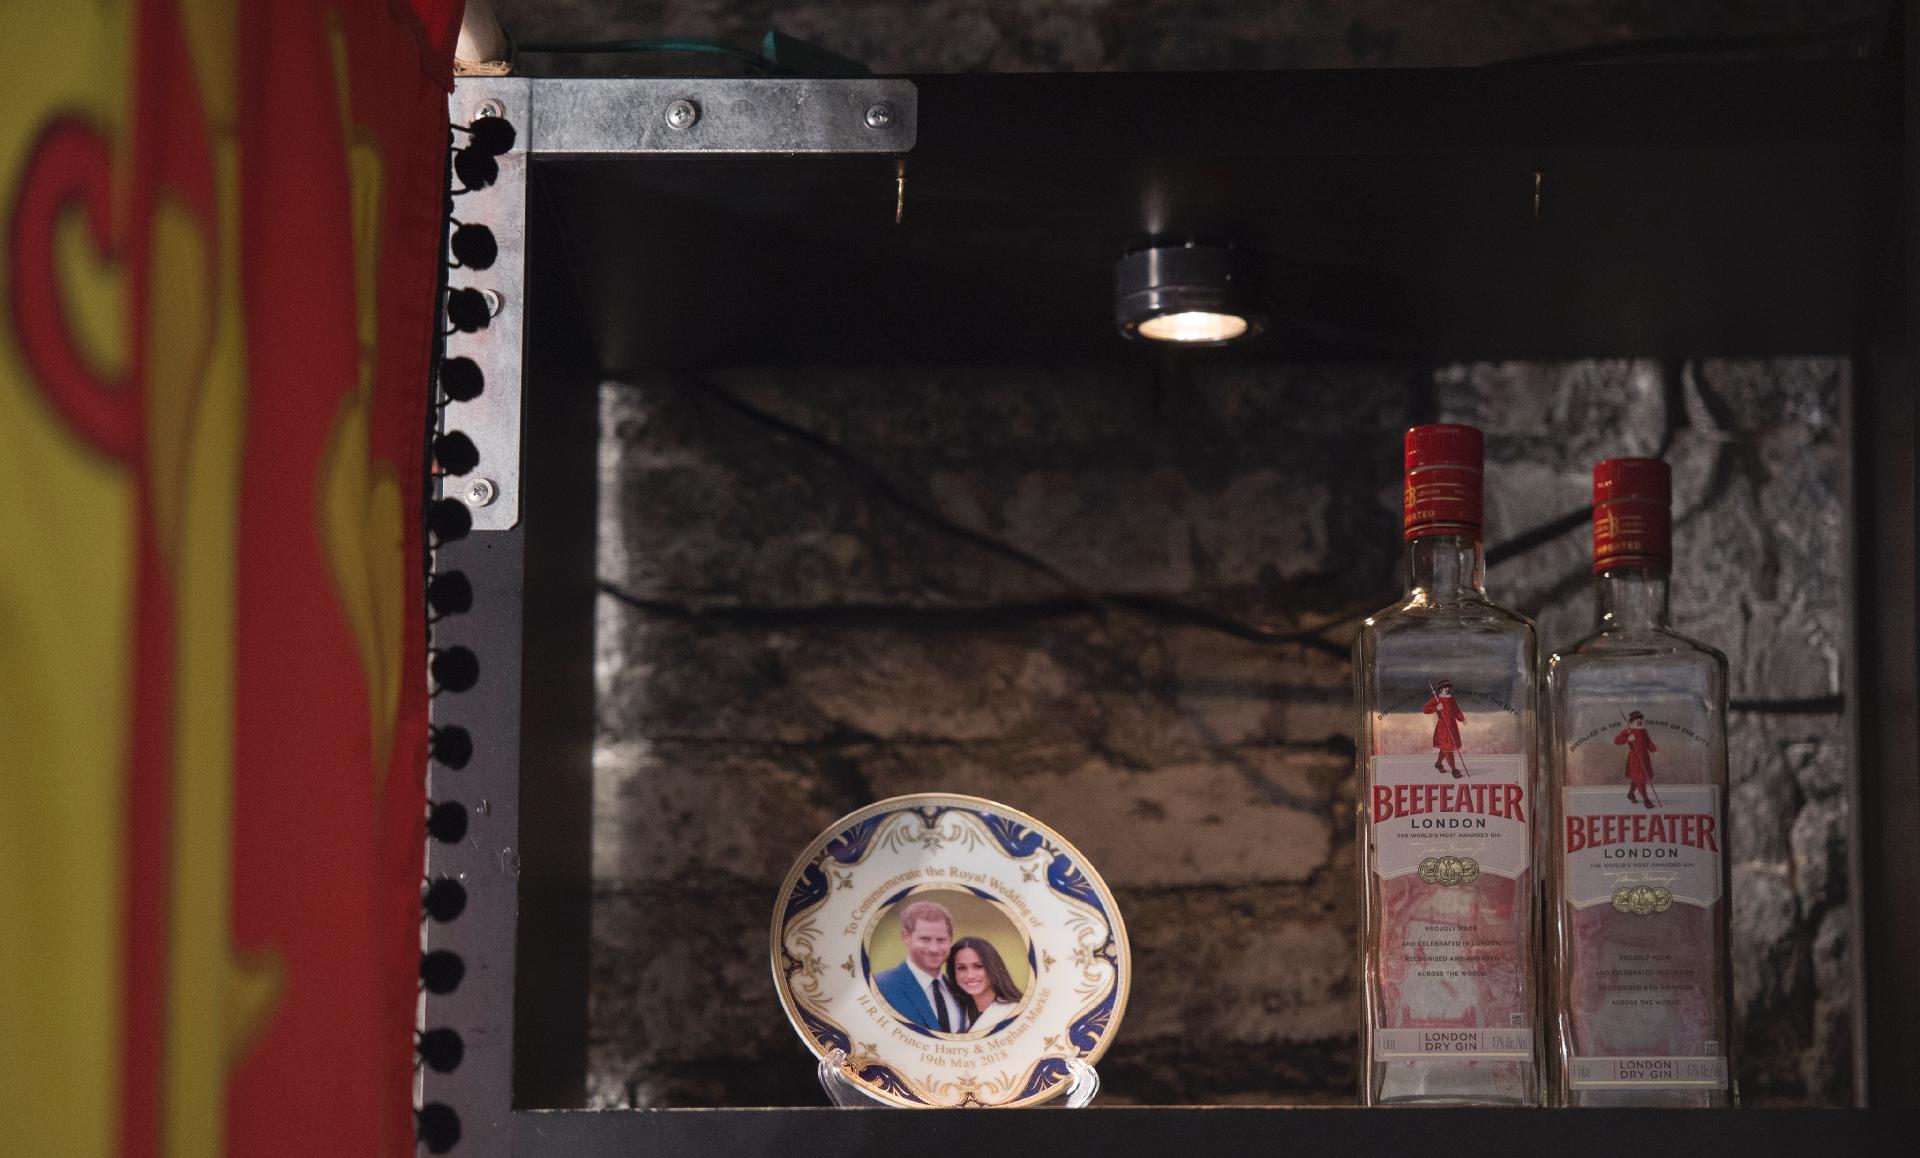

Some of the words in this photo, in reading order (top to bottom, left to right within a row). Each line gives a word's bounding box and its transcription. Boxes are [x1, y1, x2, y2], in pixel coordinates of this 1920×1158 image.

[1373, 783, 1526, 824] BEEFEATER
[1411, 818, 1486, 829] LONDON
[1566, 813, 1718, 854] BEEFEATER
[1604, 848, 1678, 859] LONDON
[843, 920, 859, 936] To
[852, 868, 922, 920] Commemorate
[926, 866, 945, 877] the
[950, 866, 986, 884] Royal
[989, 876, 1036, 919] Wedding
[1029, 914, 1044, 928] of
[892, 1027, 930, 1052] Prince
[935, 1043, 970, 1055] Harry
[974, 1043, 984, 1054] &
[987, 1023, 1030, 1052] Meghan
[1026, 986, 1050, 1023] Markle
[1425, 1032, 1477, 1041] LONDON
[1425, 1042, 1449, 1051] DRY
[1455, 1042, 1477, 1051] GIN
[919, 1053, 946, 1067] 19th
[950, 1055, 977, 1069] May
[981, 1050, 1009, 1066] 2018
[1620, 1060, 1672, 1069] LONDON
[1620, 1070, 1644, 1079] DRY
[1650, 1070, 1672, 1079] GIN
